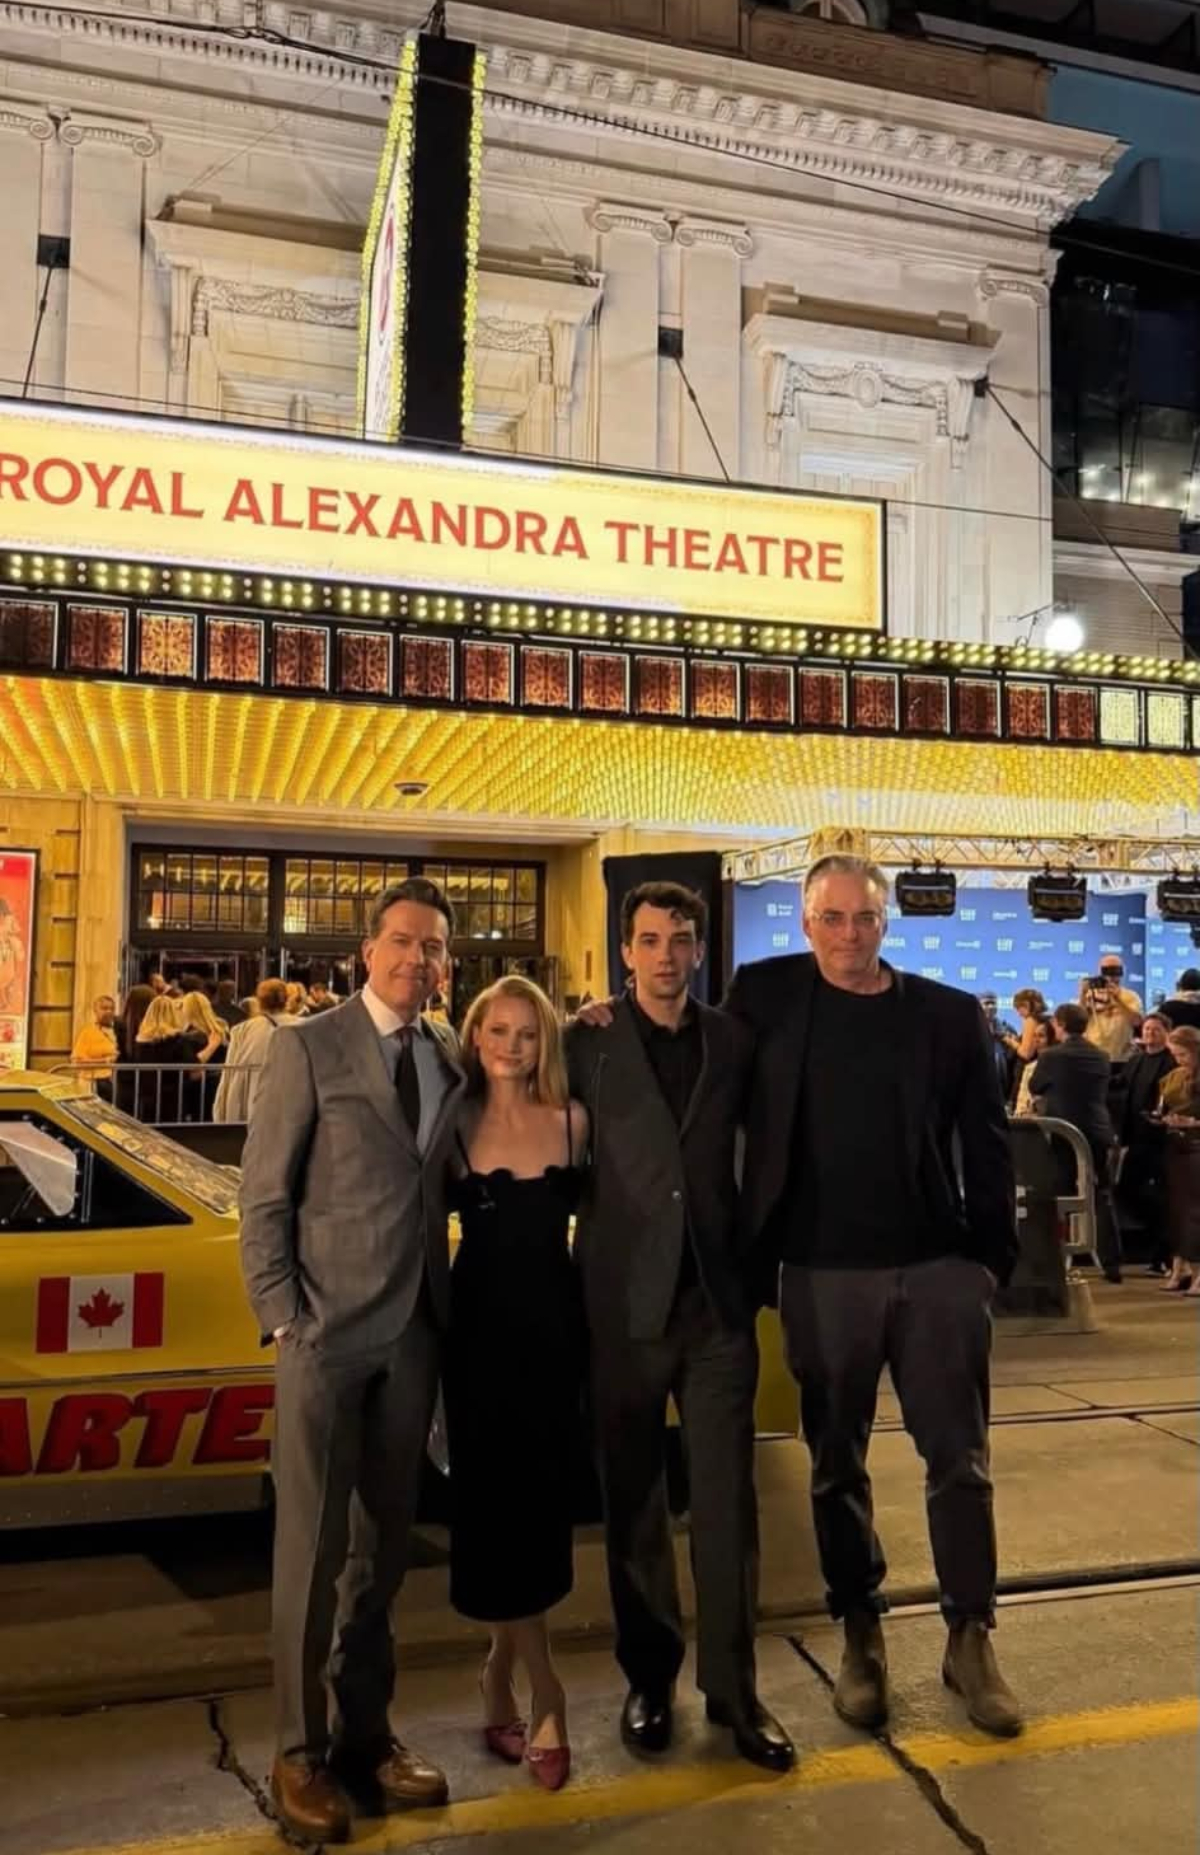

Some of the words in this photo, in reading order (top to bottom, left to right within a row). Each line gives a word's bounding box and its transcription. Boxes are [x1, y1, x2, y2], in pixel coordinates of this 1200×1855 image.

[0, 453, 204, 519] ROYAL
[223, 479, 588, 559] ALEXANDRA
[604, 521, 844, 582] THEATRE
